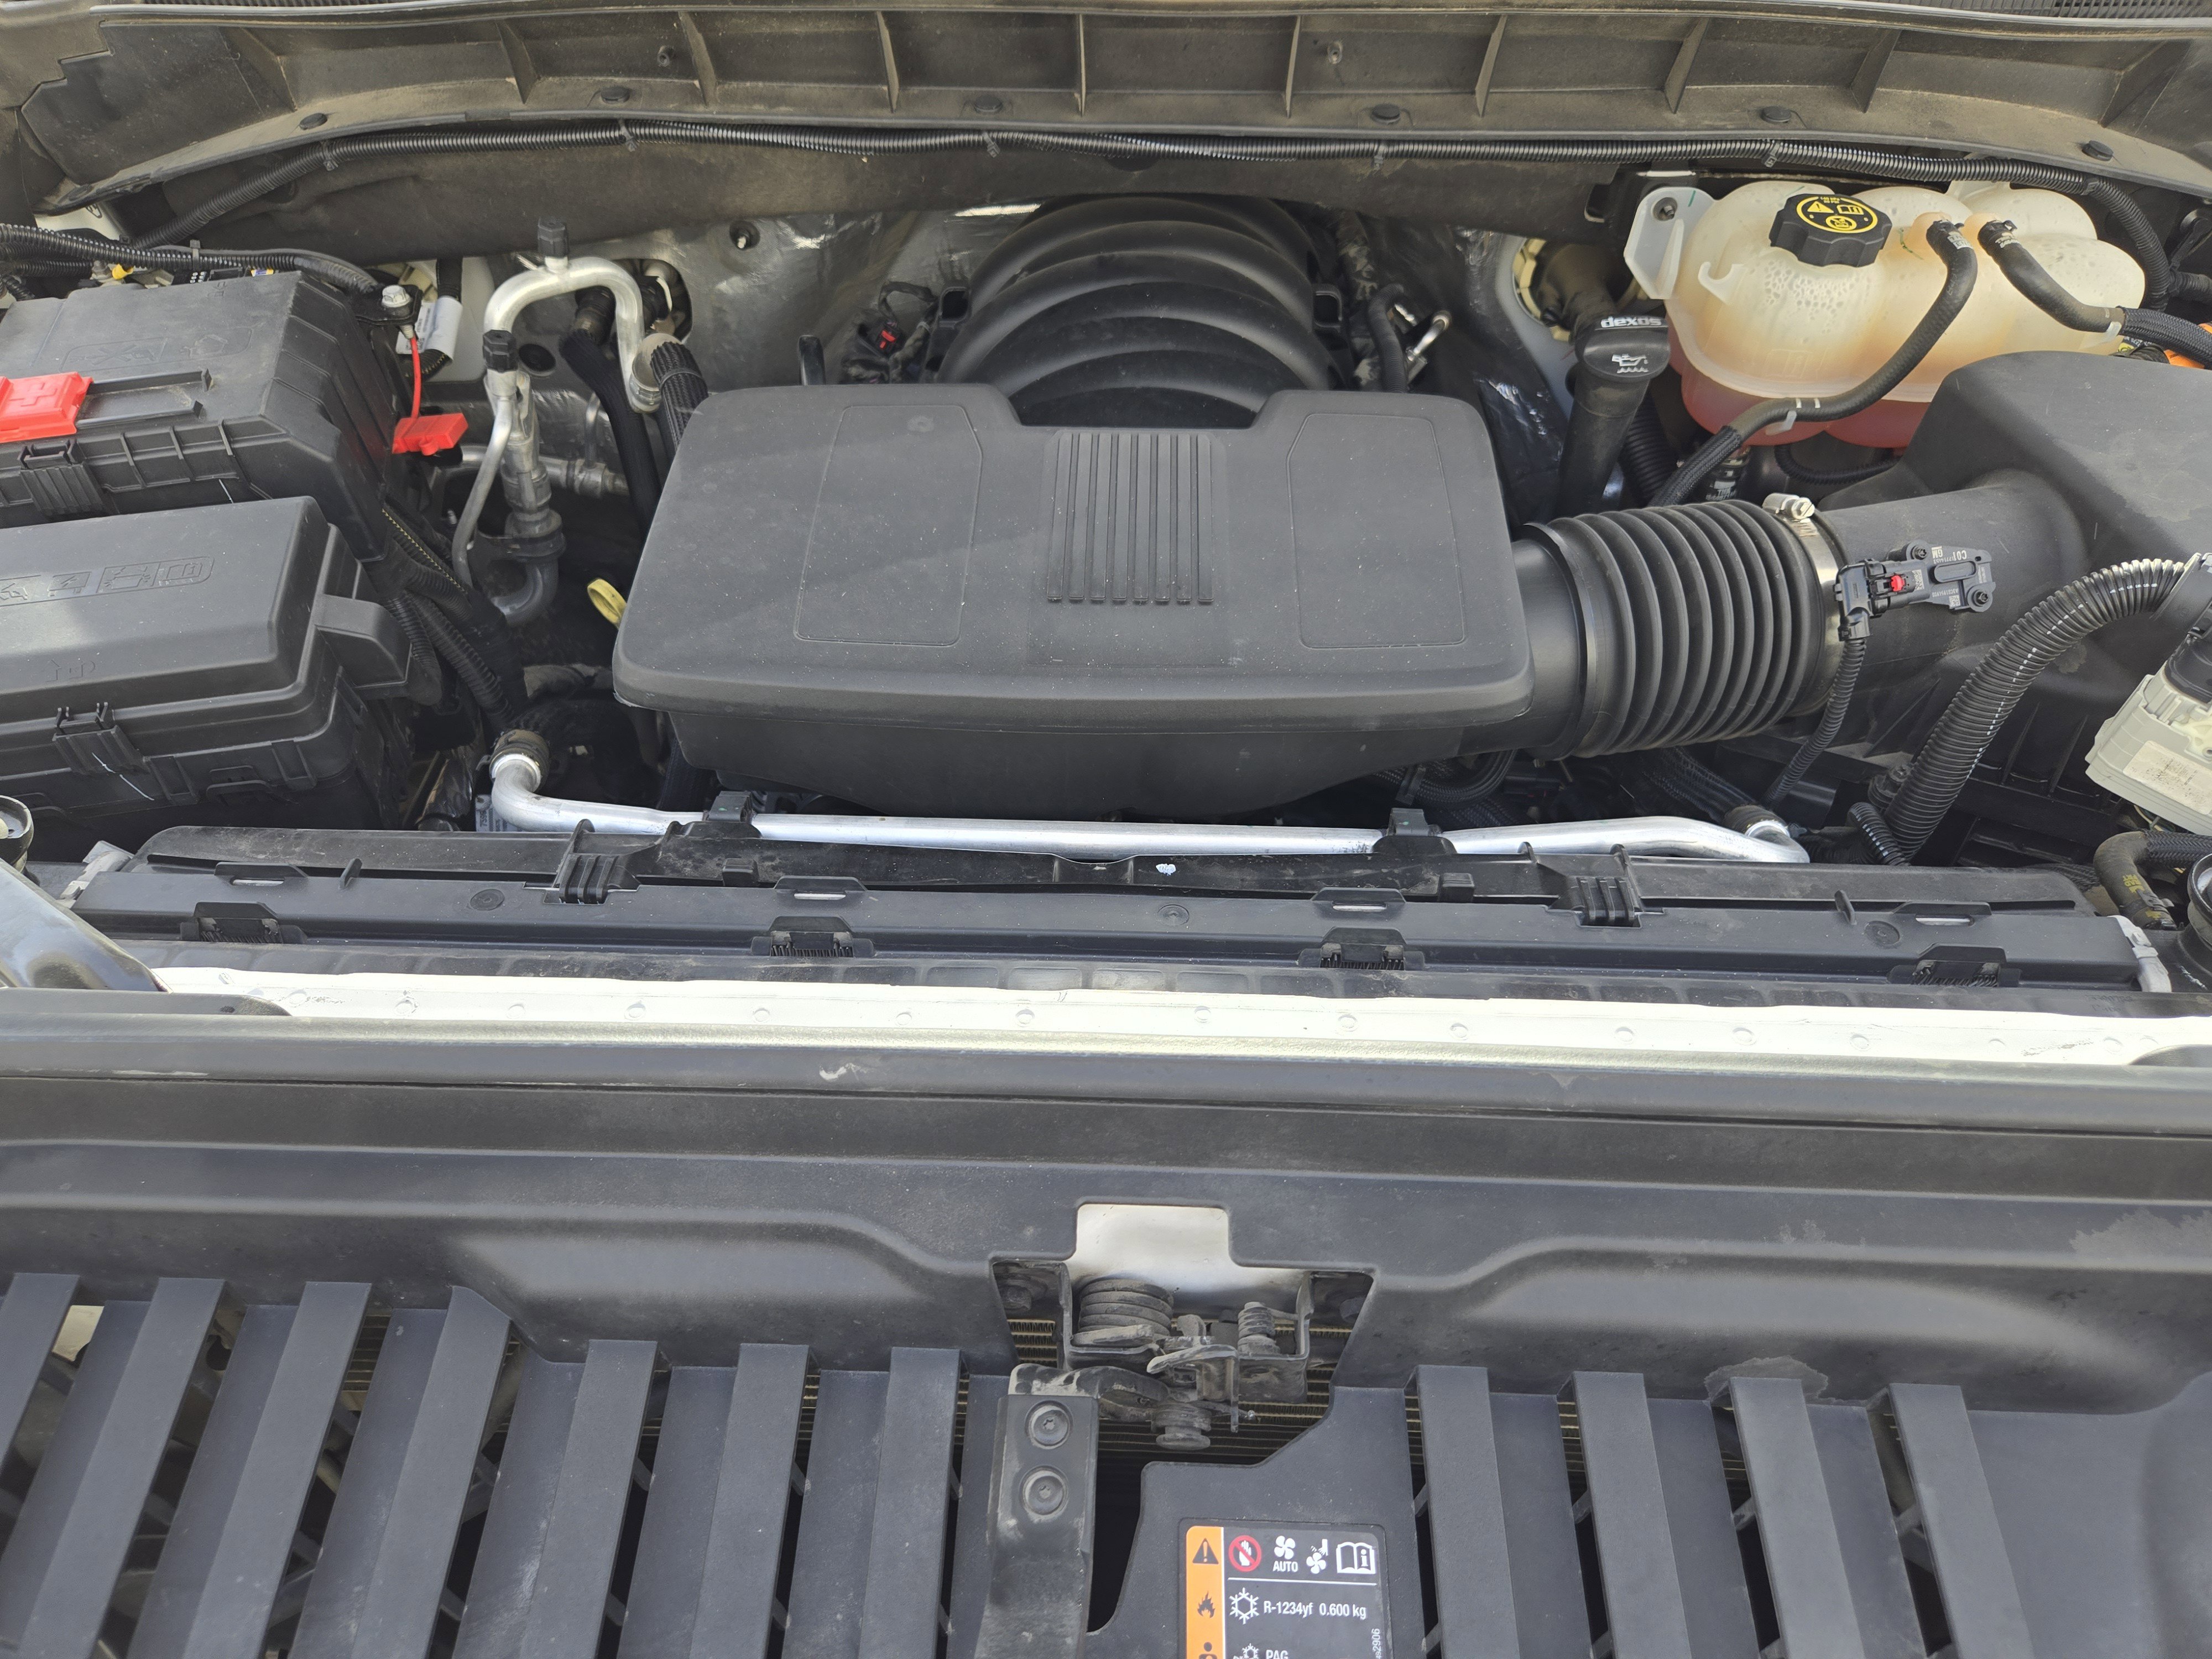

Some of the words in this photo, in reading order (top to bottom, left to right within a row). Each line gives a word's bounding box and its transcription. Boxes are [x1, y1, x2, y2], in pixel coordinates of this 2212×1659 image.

[1600, 316, 1662, 328] dexos
[1932, 549, 1943, 559] GM
[1272, 1561, 1298, 1572] AUTO
[1264, 1600, 1313, 1618] R-1234yf
[1319, 1603, 1350, 1617] 0.600
[1352, 1604, 1366, 1620] kg
[1266, 1649, 1288, 1659] PAG
